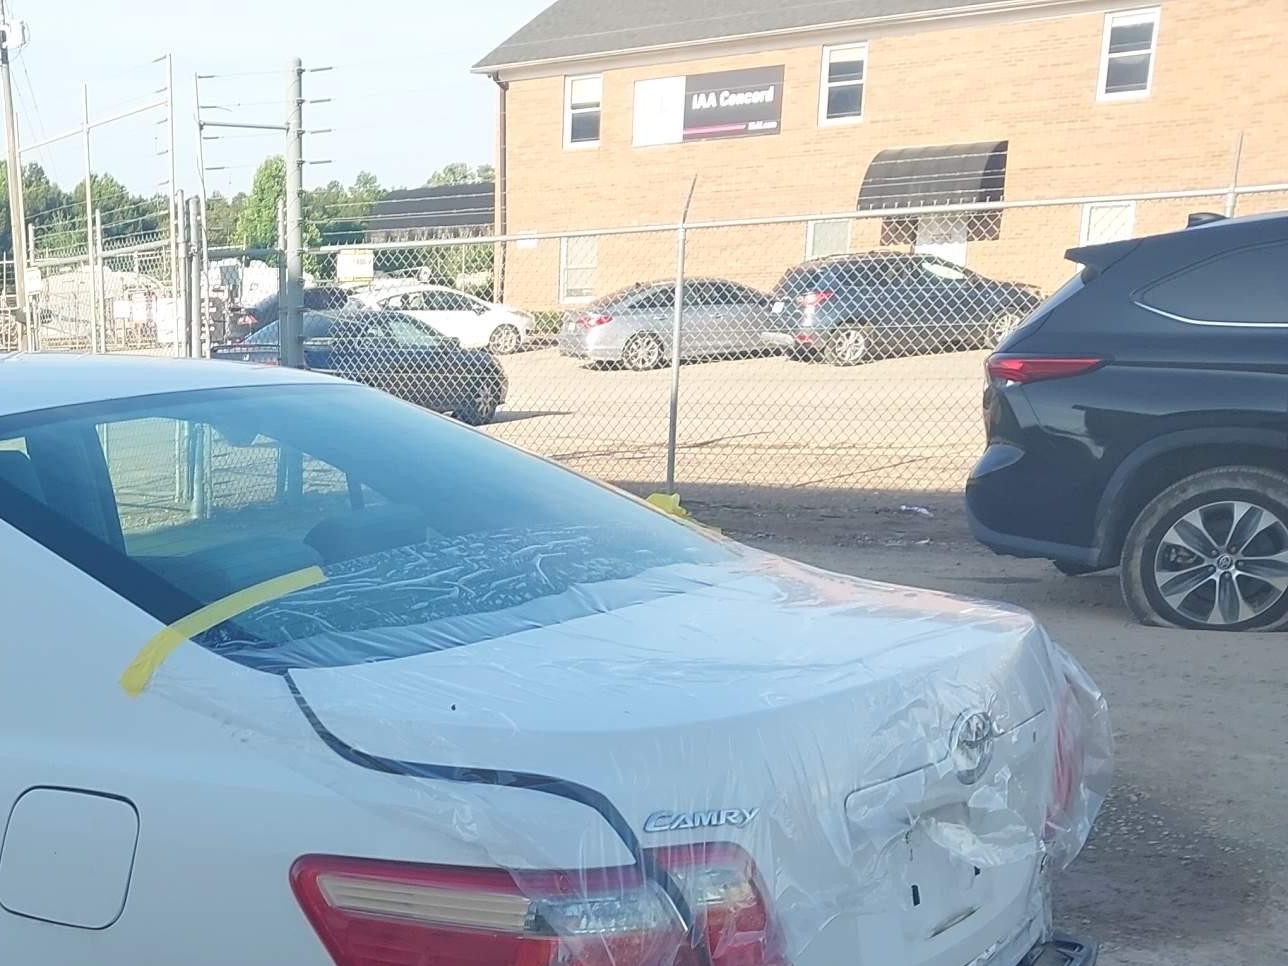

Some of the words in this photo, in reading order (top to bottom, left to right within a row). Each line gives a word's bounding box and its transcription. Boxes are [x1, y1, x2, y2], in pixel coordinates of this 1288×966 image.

[692, 92, 717, 110] IAA
[719, 85, 775, 107] Concord
[643, 807, 760, 833] CAMRY
